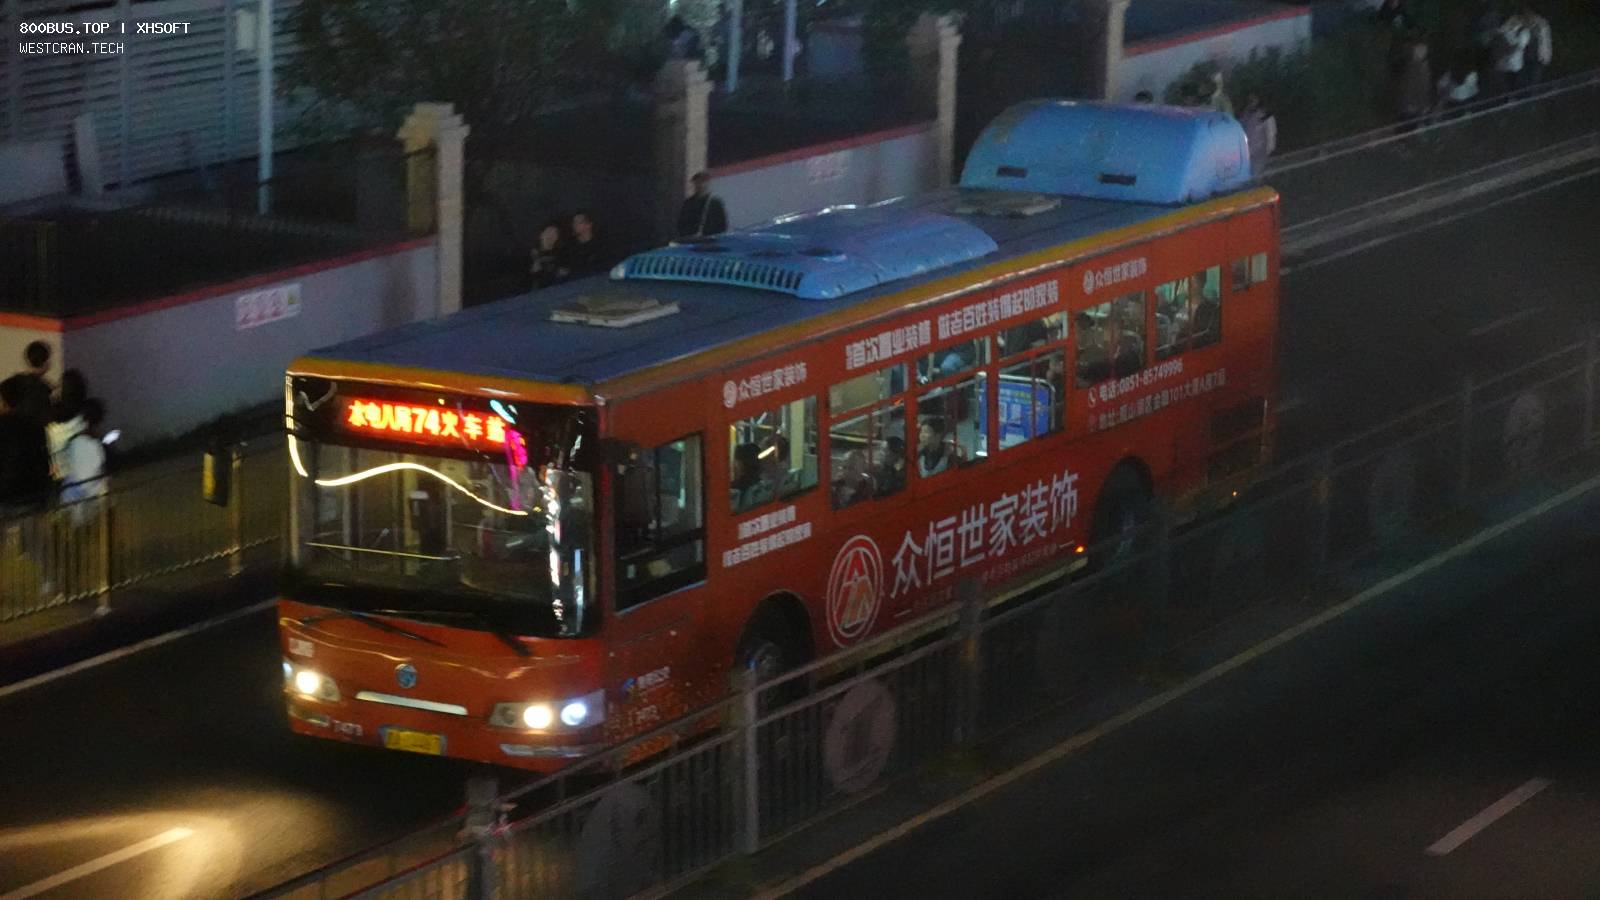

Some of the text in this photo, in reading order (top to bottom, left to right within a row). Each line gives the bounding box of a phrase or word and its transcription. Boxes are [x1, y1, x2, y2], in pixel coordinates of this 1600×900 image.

[738, 361, 807, 401] 众恒世家装饰
[890, 469, 1079, 600] 众恒世家装饰
